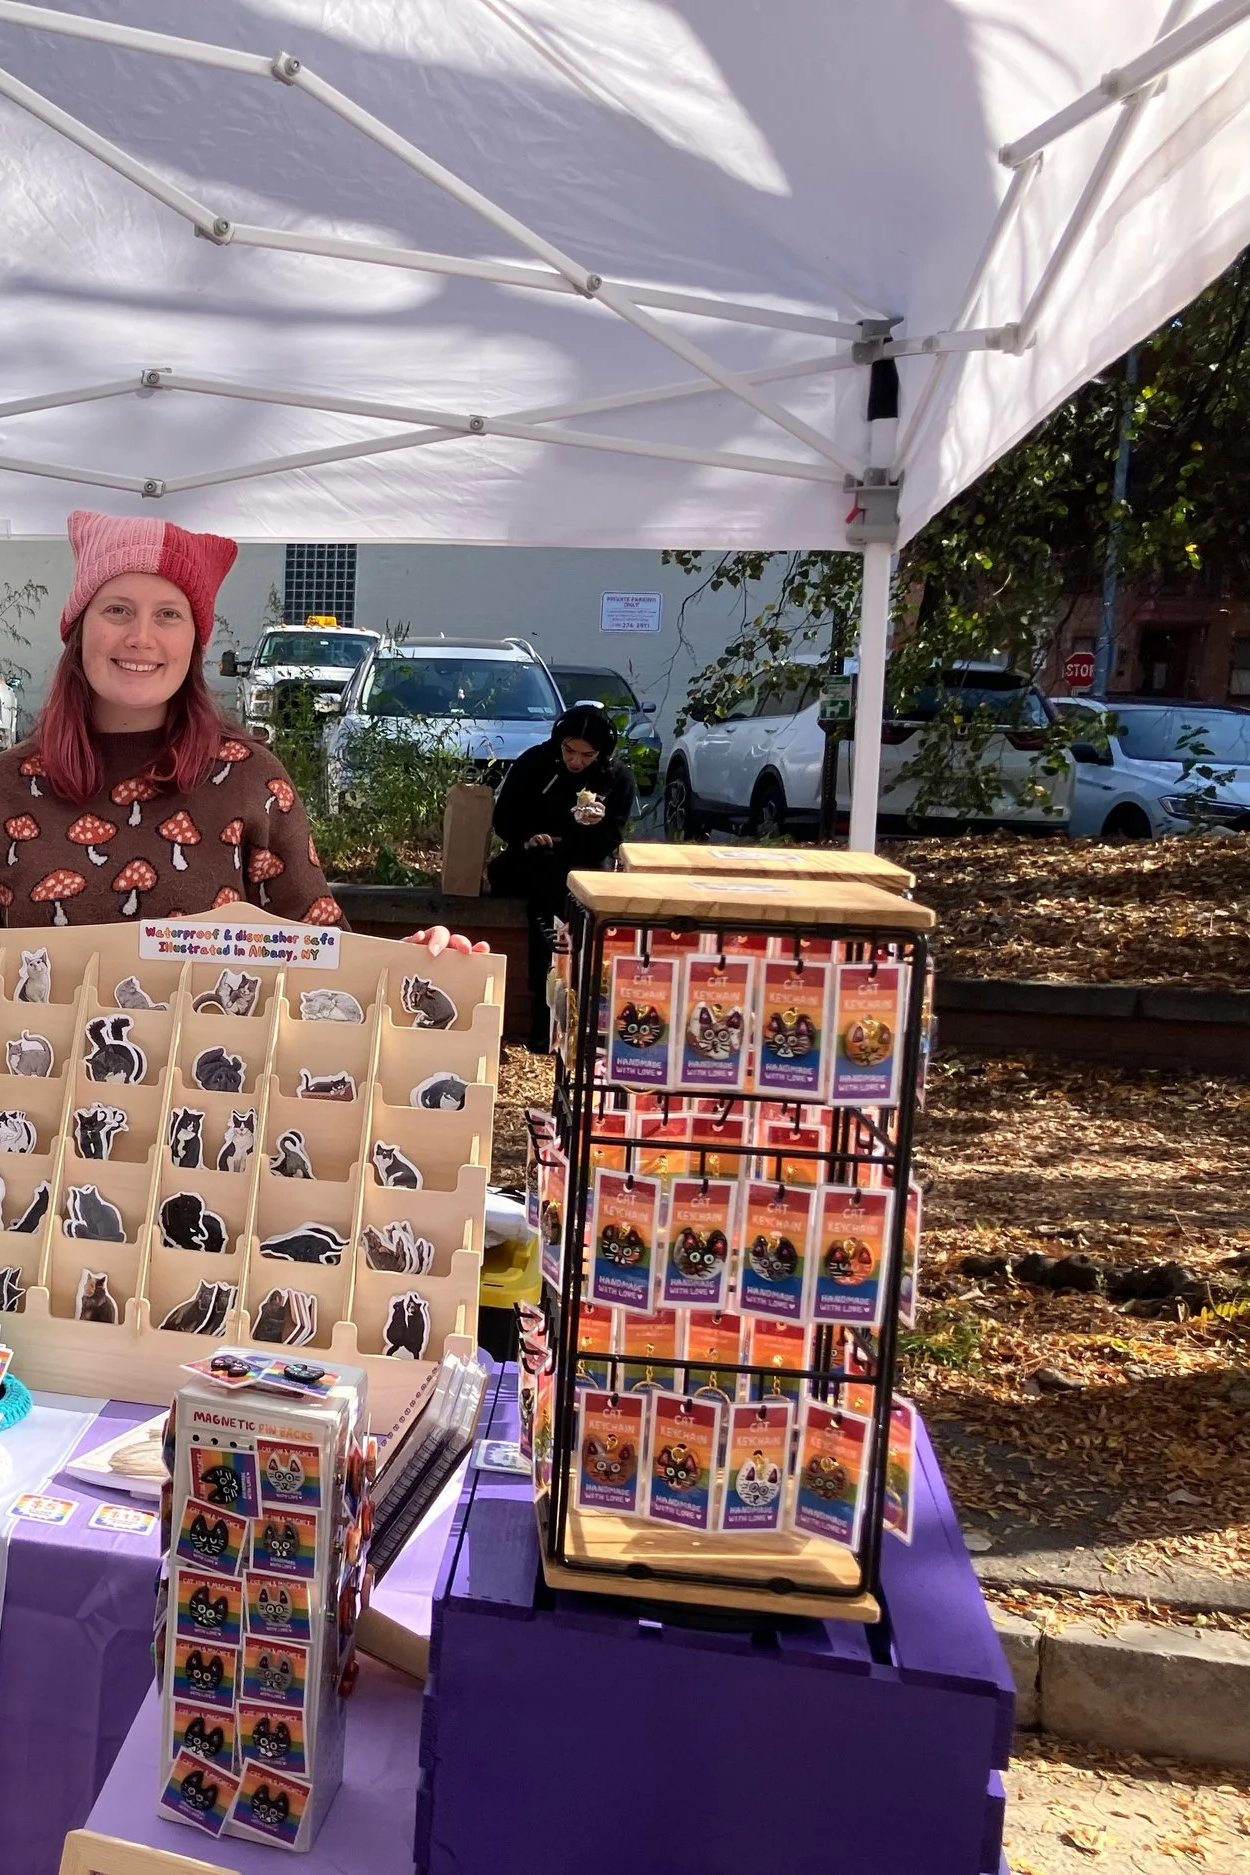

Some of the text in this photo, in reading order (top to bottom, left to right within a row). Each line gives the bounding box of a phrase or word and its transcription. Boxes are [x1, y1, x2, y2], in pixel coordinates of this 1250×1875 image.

[145, 926, 335, 946] Waterproof & diswasher safe
[158, 941, 319, 962] Illustrated in Albany, NY
[633, 975, 654, 985] CAT
[707, 976, 728, 987] CAT
[784, 980, 804, 990] CAT
[620, 988, 666, 1000] KEYCHAIN
[858, 984, 879, 995] CAT
[616, 1057, 662, 1069] HANDMADE
[687, 1061, 734, 1069] HANDMADE
[766, 1063, 813, 1075] HANDMADE
[616, 1066, 656, 1077] WITH LOVE
[707, 1069, 727, 1077] LOVE
[765, 1072, 806, 1082] WITH LOVE
[860, 1084, 879, 1092] LOVE
[617, 1193, 637, 1205] CAT
[691, 1198, 710, 1208] CAT
[603, 1204, 648, 1222] KEYCHAIN
[767, 1203, 790, 1215] CAT
[842, 1208, 865, 1220] CAT
[676, 1211, 722, 1221] KEYCHAIN
[752, 1216, 802, 1232] KEYCHAIN
[828, 1222, 879, 1235] KEYCHAIN
[599, 1276, 642, 1292] HANDMADE
[670, 1279, 715, 1288] HANDMADE
[598, 1285, 637, 1299] WITH LOVE
[670, 1287, 708, 1296] WITH LOVE
[747, 1286, 795, 1302] HANDMADE
[746, 1296, 789, 1310] WITH LOVE
[821, 1295, 870, 1306] HANDMADE
[820, 1304, 863, 1313] WITH LOVE
[602, 1408, 623, 1418] CAT
[193, 1411, 314, 1440] MAGNETIC PIN BACKS
[589, 1420, 635, 1433] KEYCHAIN
[674, 1415, 695, 1427] CAT
[750, 1421, 770, 1433] CAT
[660, 1426, 708, 1444] KEYCHAIN
[824, 1427, 845, 1438] CAT
[736, 1436, 781, 1446] KEYCHAIN
[585, 1484, 631, 1496] HANDMADE
[606, 1494, 624, 1503] LOVE
[656, 1495, 702, 1512] HANDMADE
[655, 1504, 696, 1519] WITH LOVE
[729, 1506, 773, 1515] HANDMADE
